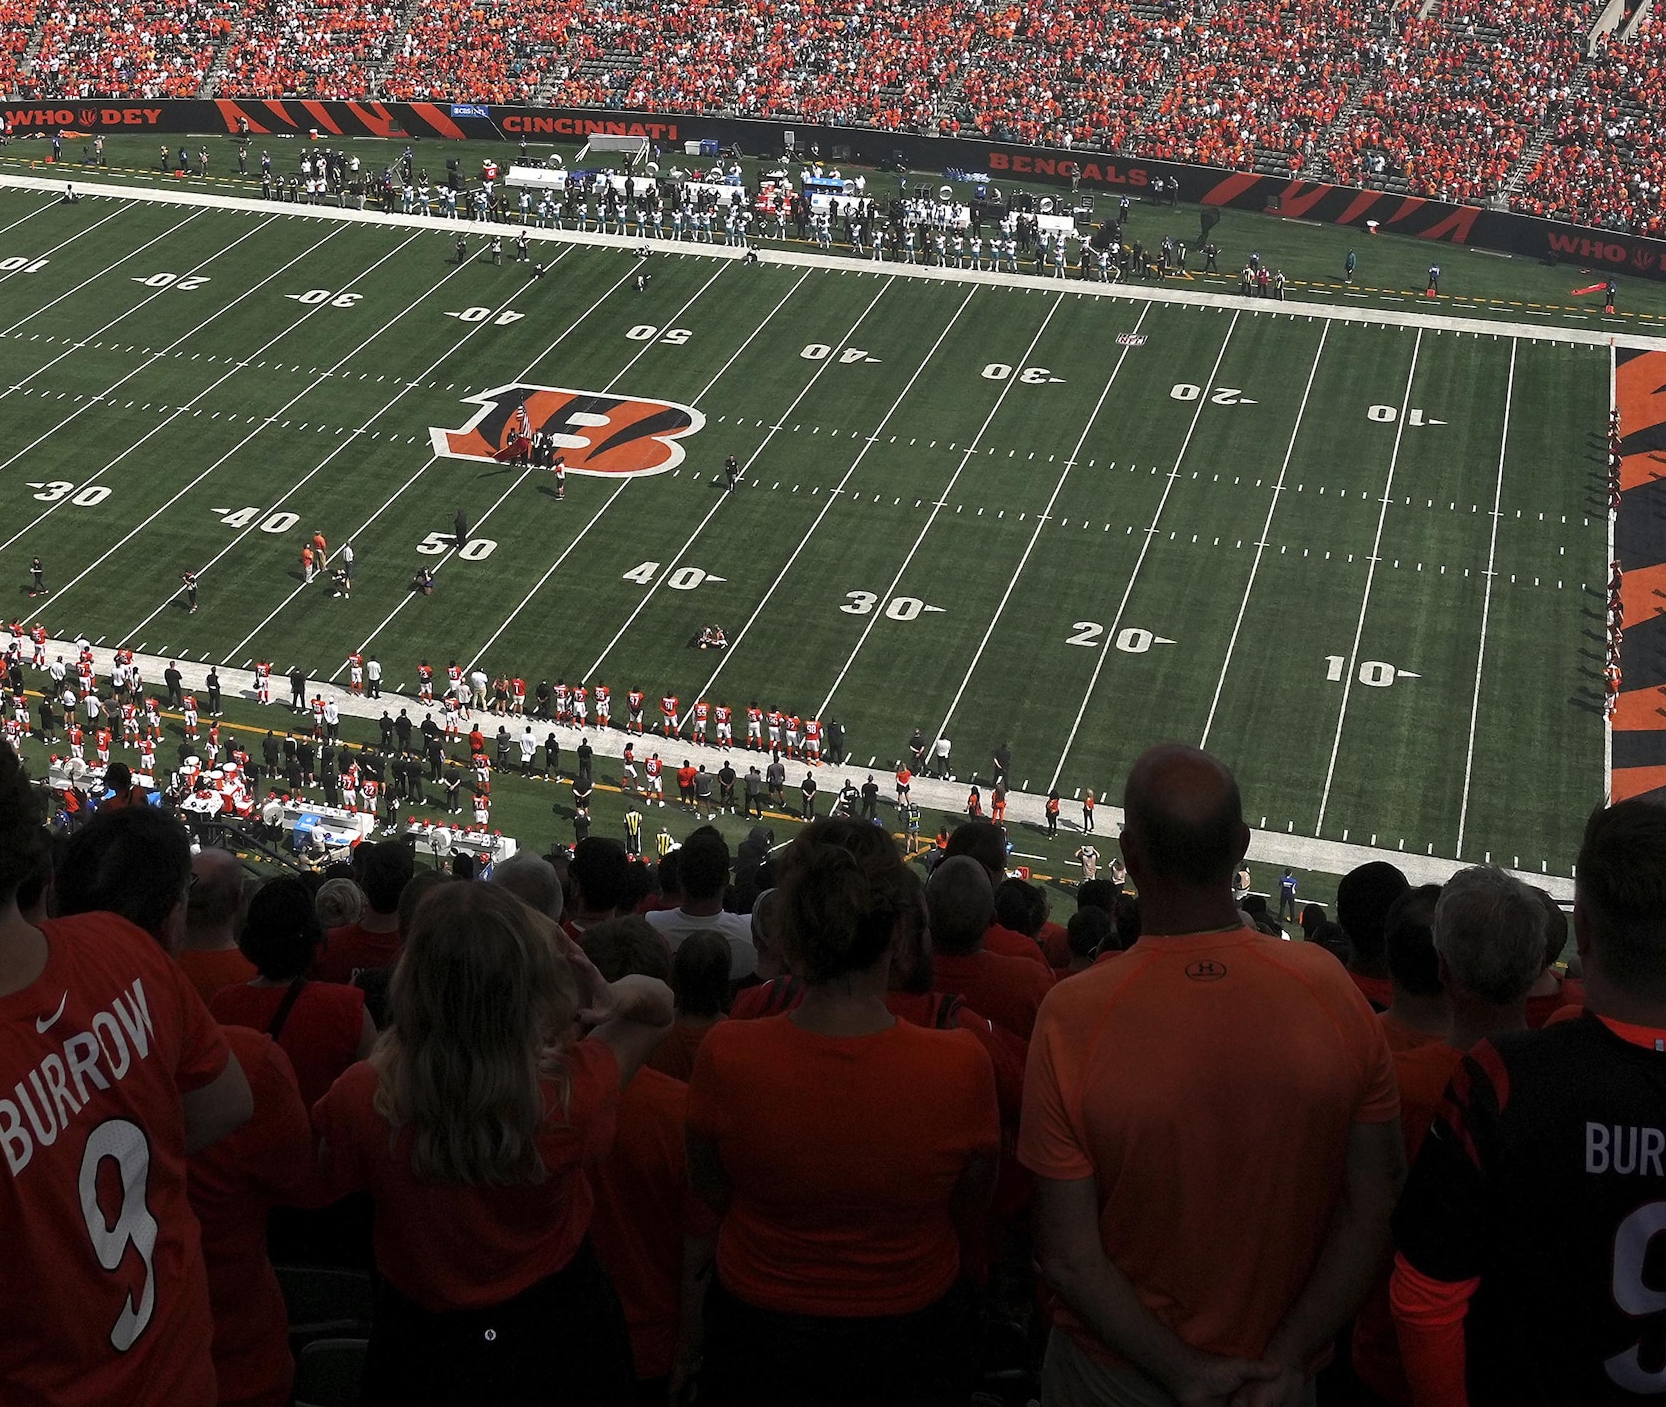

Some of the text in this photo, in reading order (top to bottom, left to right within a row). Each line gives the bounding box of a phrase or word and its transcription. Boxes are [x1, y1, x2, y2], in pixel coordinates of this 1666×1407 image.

[5, 108, 162, 126] WHO DEY
[503, 116, 678, 140] CINCINNATI
[989, 152, 1148, 187] BENGALS
[1548, 231, 1628, 263] WHO
[144, 272, 211, 291] 20
[296, 288, 364, 309] 30
[456, 306, 525, 326] 40
[625, 325, 694, 346] 50
[799, 343, 867, 364] 40
[981, 363, 1053, 386] 30
[1170, 383, 1243, 406] 20
[1367, 404, 1429, 427] 10
[33, 481, 113, 507] 30
[221, 506, 300, 534] 40
[416, 531, 497, 561] 50
[622, 561, 707, 591] 40
[839, 590, 925, 621] 30
[1065, 621, 1154, 653] 20
[1325, 655, 1397, 688] 10
[78, 1118, 158, 1352] 9
